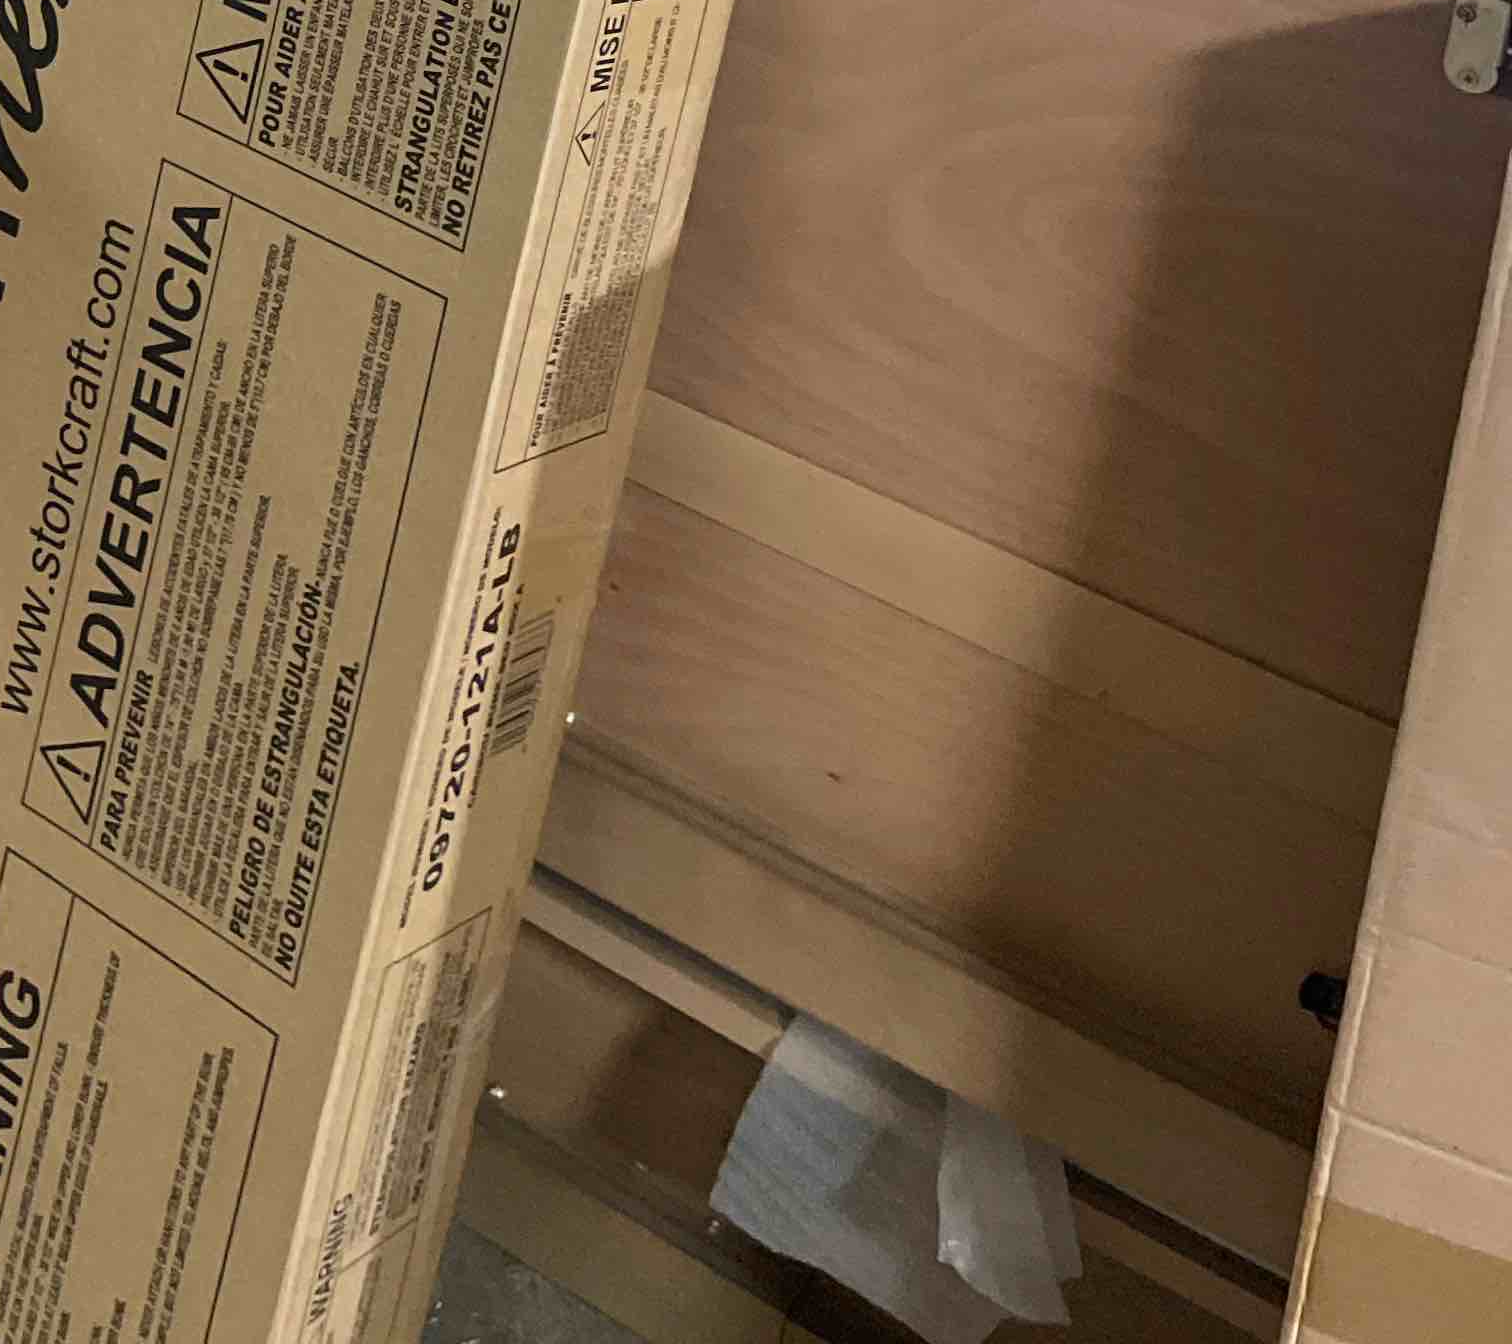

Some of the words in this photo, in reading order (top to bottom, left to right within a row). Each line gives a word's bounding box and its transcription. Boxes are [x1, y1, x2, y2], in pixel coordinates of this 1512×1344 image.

[272, 3, 305, 80] AIDER
[474, 36, 503, 87] PAS
[585, 13, 630, 94] MISE
[257, 78, 289, 149] POUR
[392, 8, 456, 215] STRANGULATION
[449, 89, 491, 197] RETIREZ
[440, 195, 466, 237] NO
[1, 218, 136, 715] www.storkcraft.com
[64, 186, 222, 730] ADVERTENCIA
[112, 665, 155, 788] PREVENIR
[314, 652, 362, 787] ETIQUETA.
[420, 519, 523, 895] 09720-121A-LB
[98, 783, 129, 855] PARA
[299, 782, 331, 854] ESTA
[228, 828, 269, 941] PELIGRO
[252, 794, 276, 831] DE
[282, 849, 318, 934] QUITE
[273, 927, 299, 972] NO
